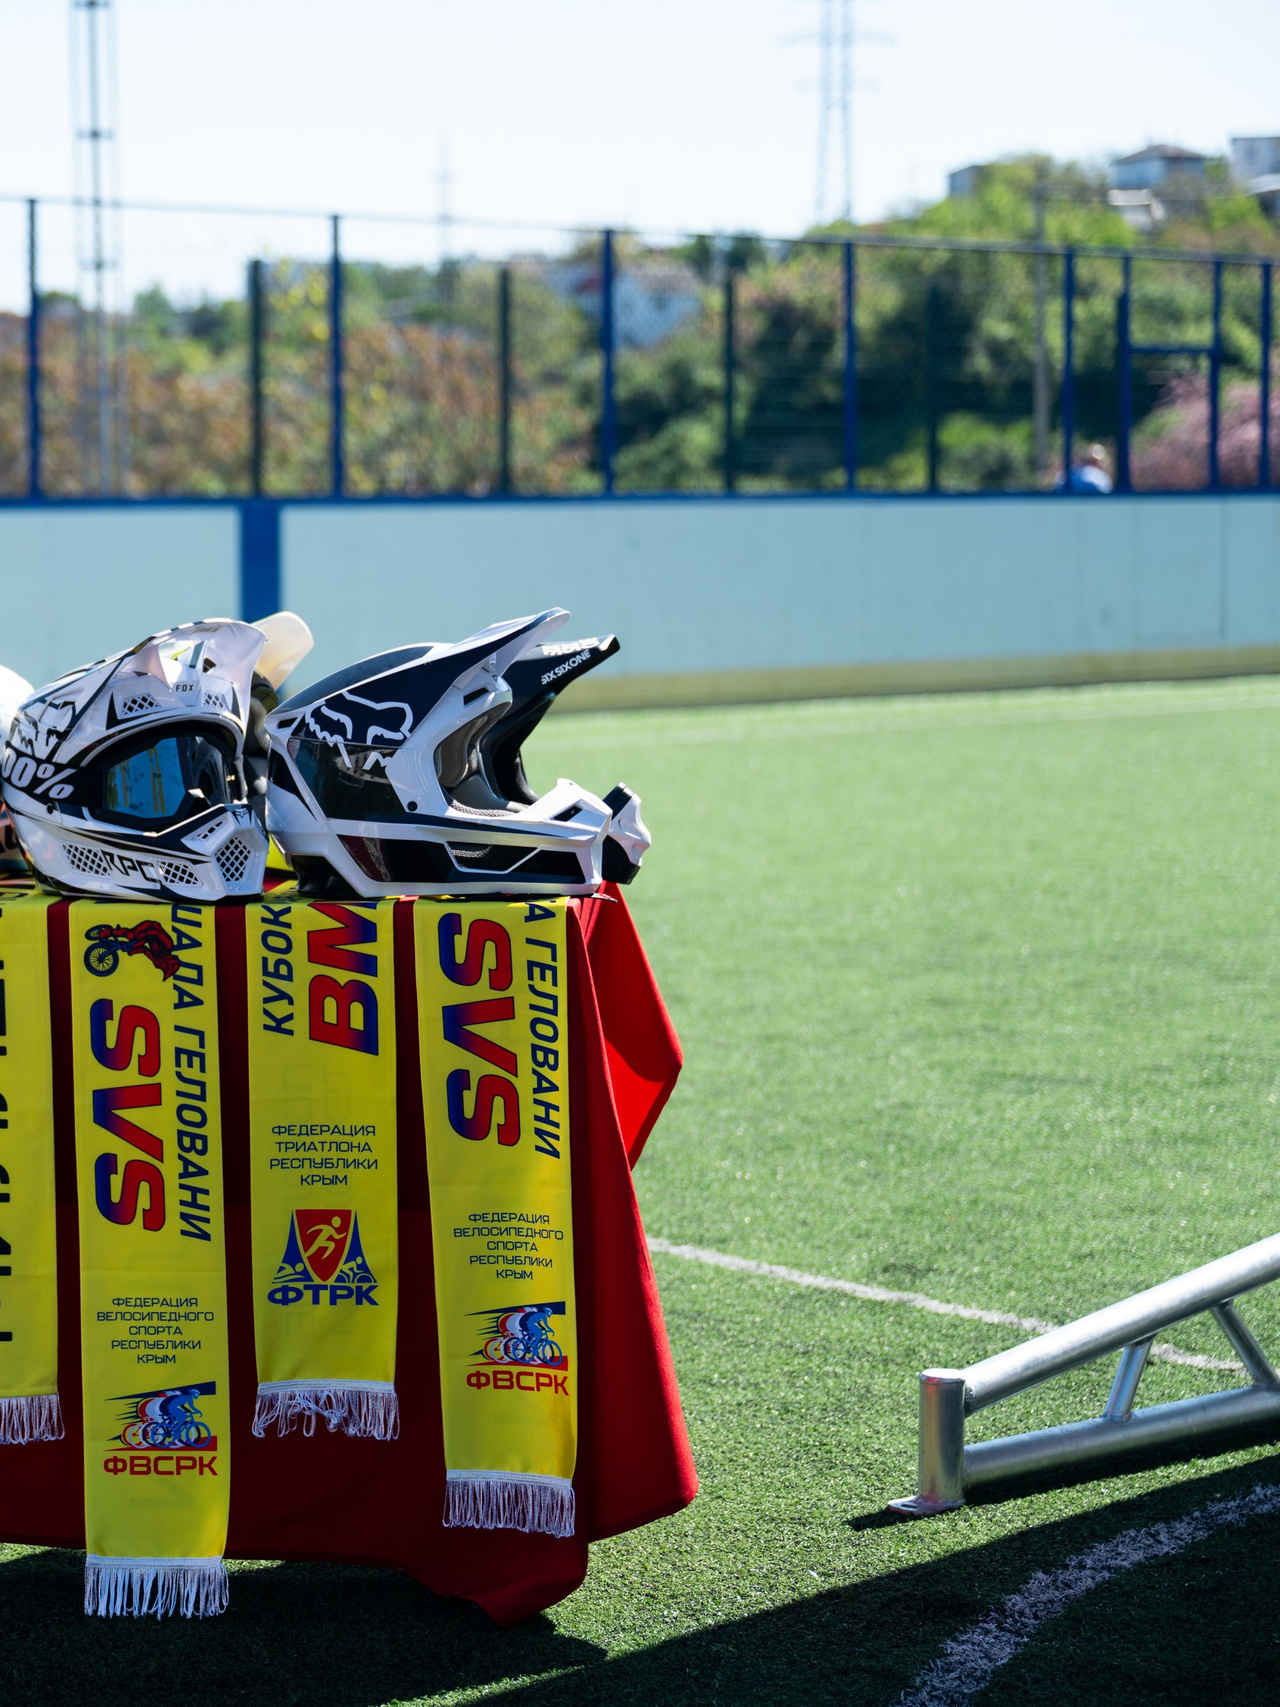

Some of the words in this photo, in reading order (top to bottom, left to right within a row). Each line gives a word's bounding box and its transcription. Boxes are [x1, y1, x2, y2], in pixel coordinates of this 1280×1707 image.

[175, 684, 194, 692] FOX
[2, 747, 75, 799] 00%
[100, 848, 162, 884] RPC
[261, 905, 294, 1036] КУБОК
[438, 913, 520, 1146] SVS
[526, 938, 560, 1159] ГЕЛОВАНИ
[90, 999, 165, 1231] SVS
[174, 1025, 211, 1241] ГЕЛОВАНИ
[272, 1125, 375, 1137] ФЕДЕРАЦИЯ
[276, 1141, 372, 1152] ТРИАТЛОНА
[270, 1158, 377, 1169] РЕСПУБЛИКИ
[301, 1175, 347, 1185] КРЫМ
[469, 1213, 549, 1224] ФЕДЕРАЦИЯ
[454, 1227, 563, 1240] ВЕЛОСИПЕДНОГО
[487, 1241, 538, 1251] СПОРТА
[470, 1255, 552, 1267] РЕСПУБЛИКИ
[496, 1270, 532, 1279] КРЫМ
[267, 1285, 378, 1306] ФТРК
[112, 1298, 197, 1308] ФЕДЕРАЦИЯ
[97, 1312, 214, 1322] ВЕЛОСИПЕДНОГО
[129, 1326, 183, 1335] СПОРТА
[112, 1340, 201, 1349] РЕСПУБЛИКИ
[138, 1354, 175, 1363] КРЫМ
[466, 1370, 569, 1395] ФВСРК
[104, 1456, 217, 1475] ФВСРК
